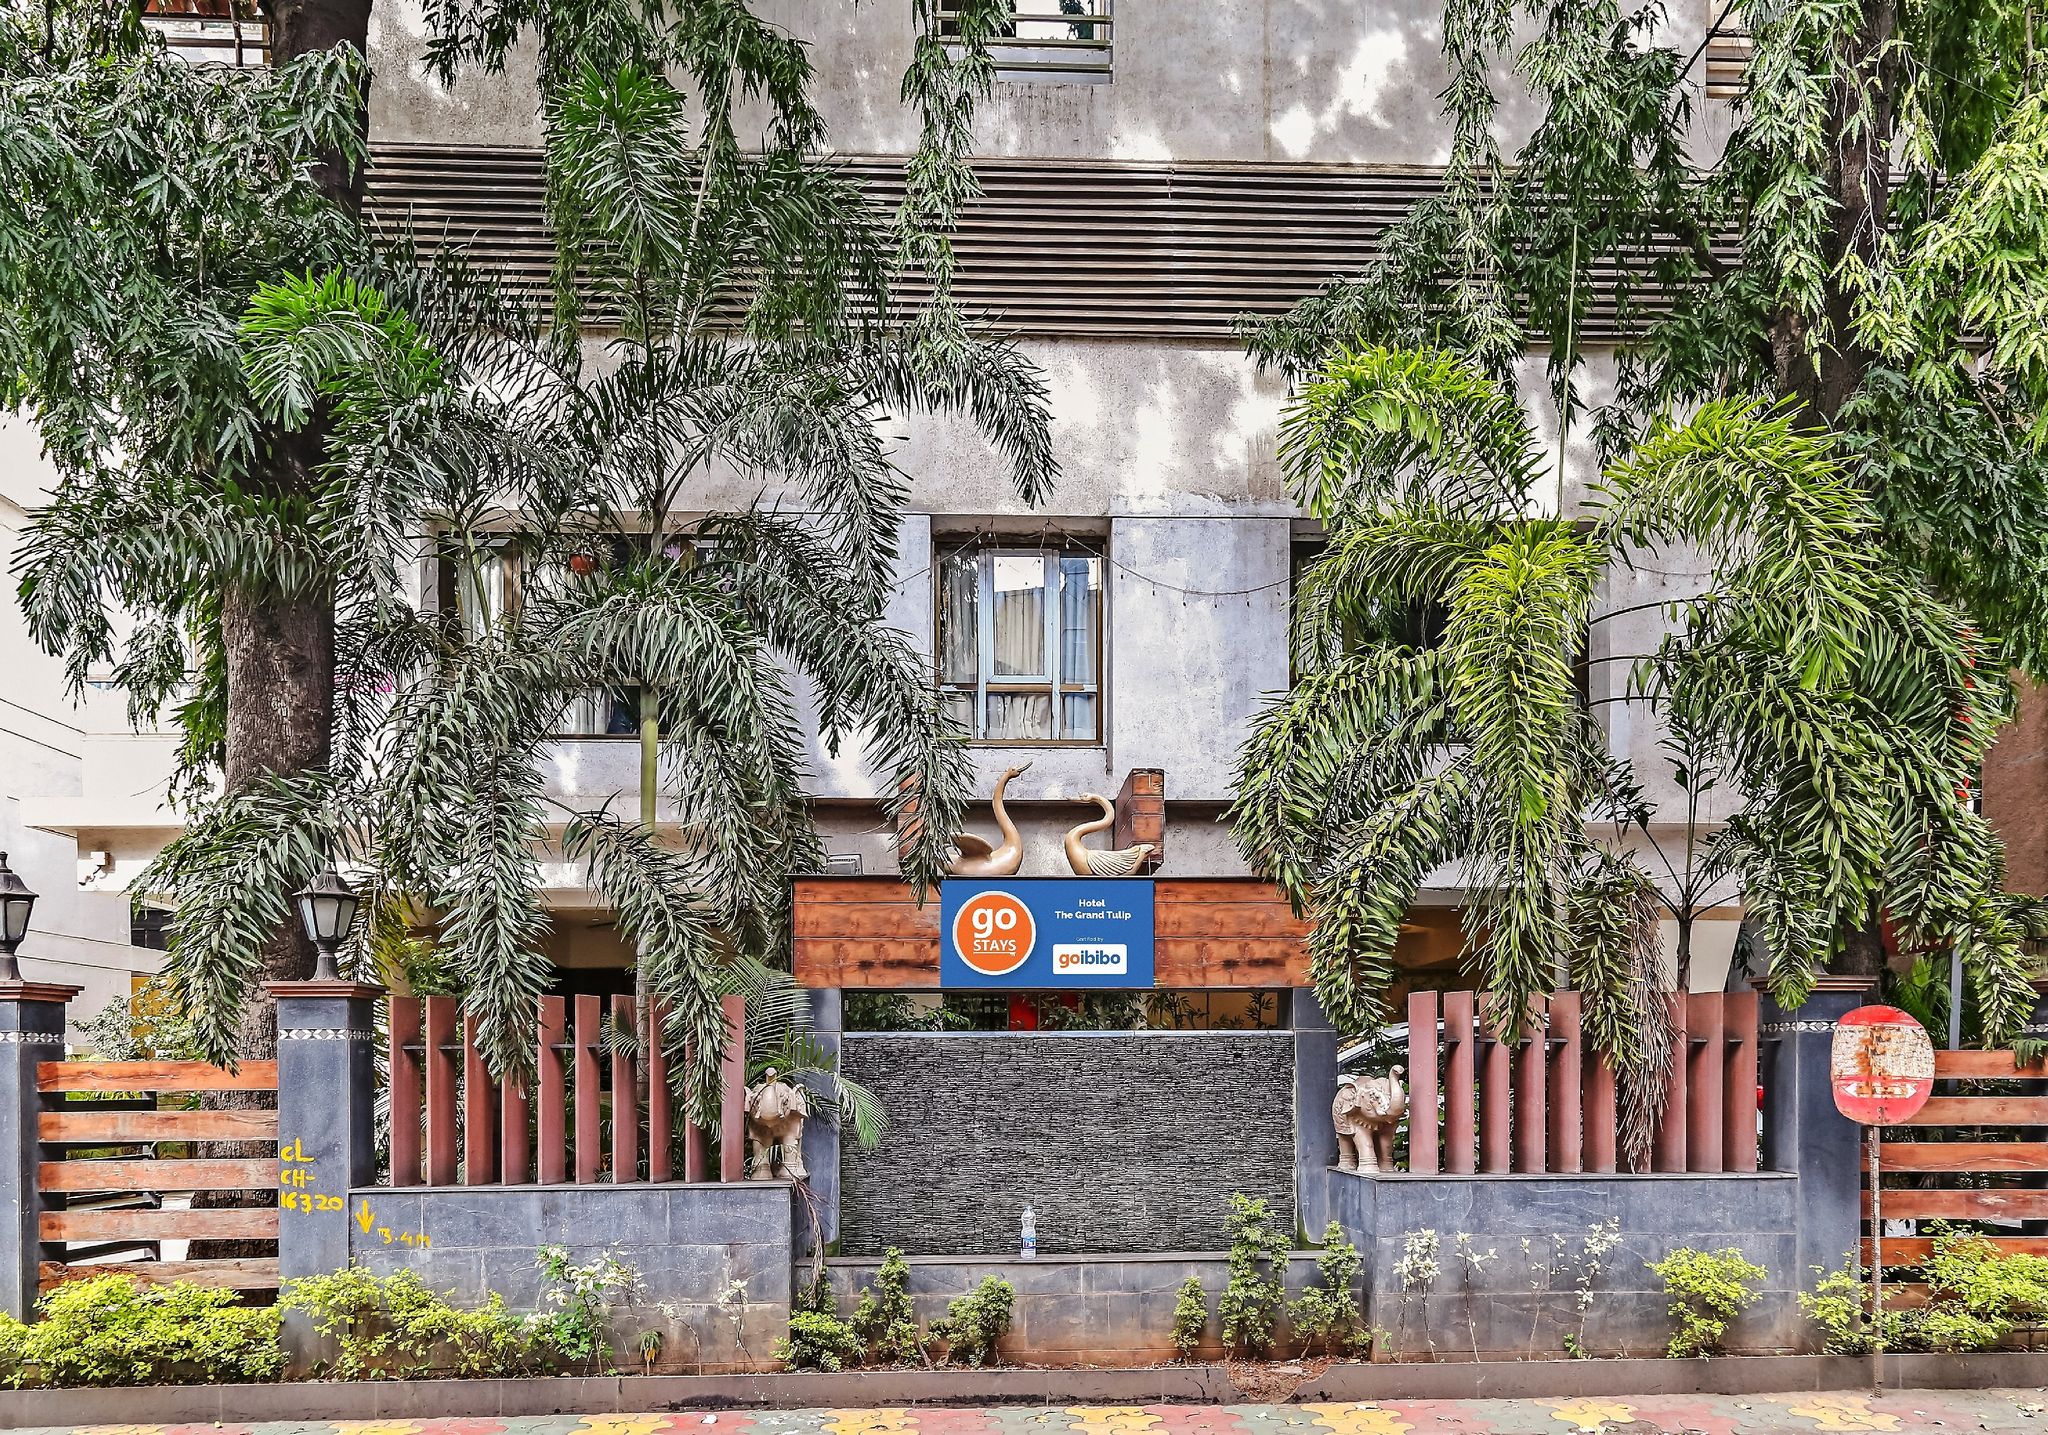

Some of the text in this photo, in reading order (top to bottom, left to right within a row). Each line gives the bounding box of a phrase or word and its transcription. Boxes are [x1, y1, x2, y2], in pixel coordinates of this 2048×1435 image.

[1078, 898, 1106, 907] Hotel
[972, 907, 1017, 939] go
[1055, 910, 1132, 921] The Grand Tulip
[973, 939, 1017, 952] STAYS
[1059, 950, 1121, 969] goibibo
[280, 1190, 344, 1215] 16320
